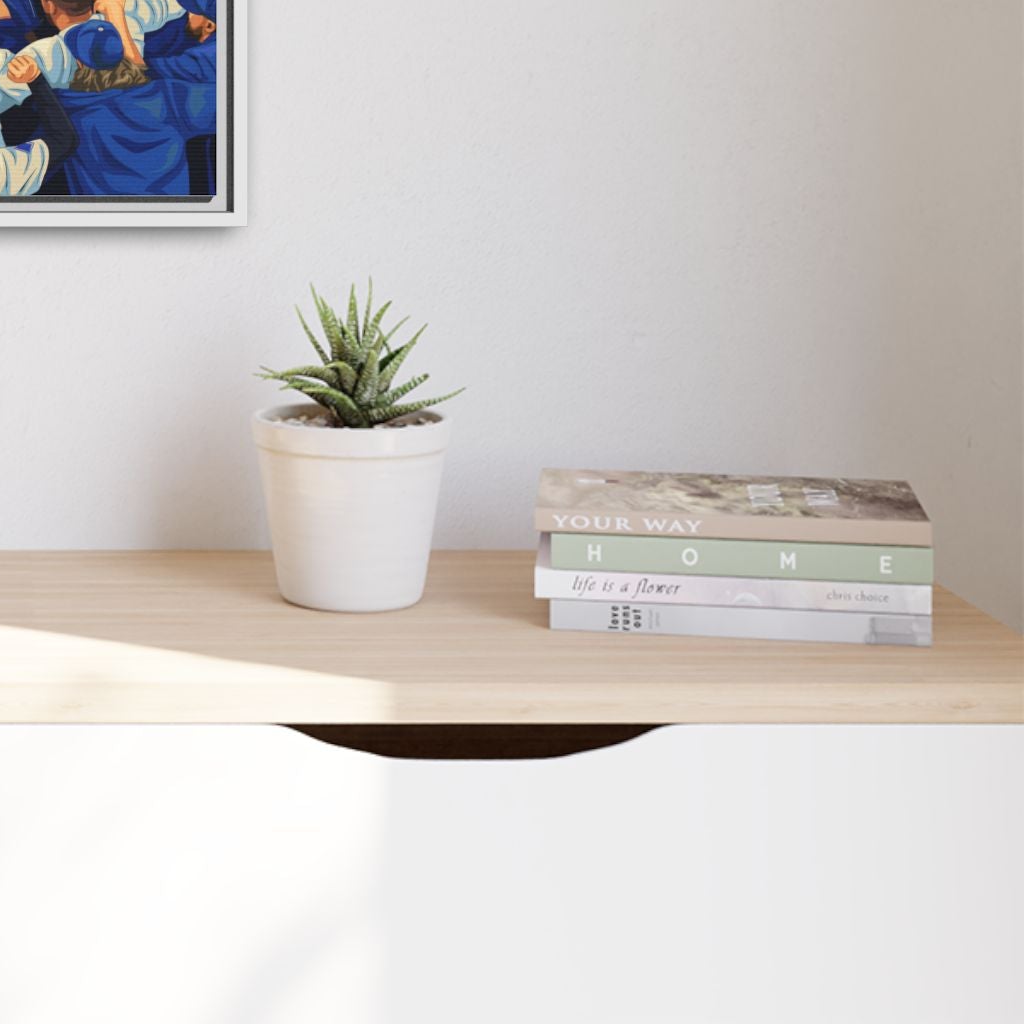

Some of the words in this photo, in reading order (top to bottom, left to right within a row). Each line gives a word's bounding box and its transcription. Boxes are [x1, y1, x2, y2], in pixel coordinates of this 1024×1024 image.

[552, 514, 632, 531] YOUR
[642, 517, 703, 533] WAY
[572, 575, 596, 596] life
[602, 578, 615, 593] is
[619, 582, 629, 593] a
[632, 577, 682, 598] flower
[826, 590, 852, 602] chris
[854, 590, 890, 603] choice
